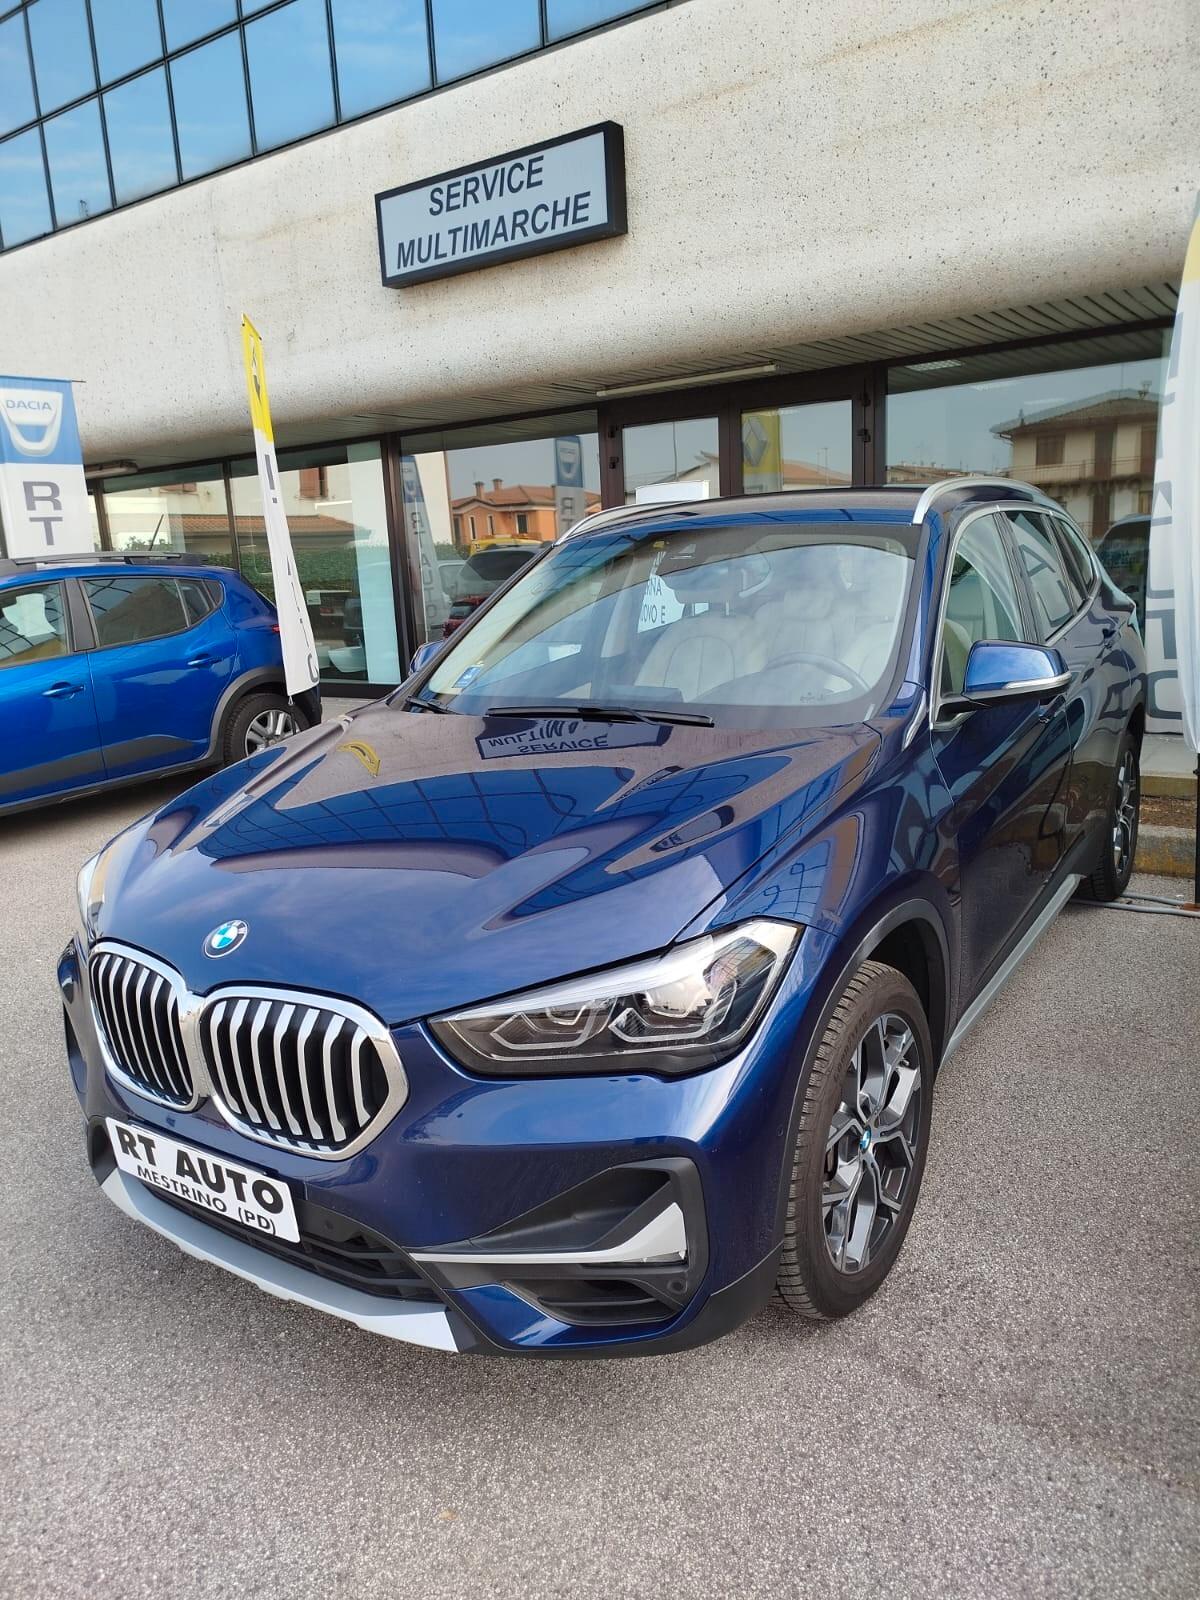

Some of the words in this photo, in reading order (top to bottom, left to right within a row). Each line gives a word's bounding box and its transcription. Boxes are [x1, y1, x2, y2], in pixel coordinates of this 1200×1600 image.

[429, 155, 544, 216] SERVICE
[397, 191, 591, 269] MULTIMARCHE
[6, 399, 52, 411] DACIA
[115, 1125, 157, 1166] RT
[175, 1149, 284, 1215] AUTO
[137, 1165, 227, 1213] MESTRINO
[239, 1207, 276, 1236] (PD)
